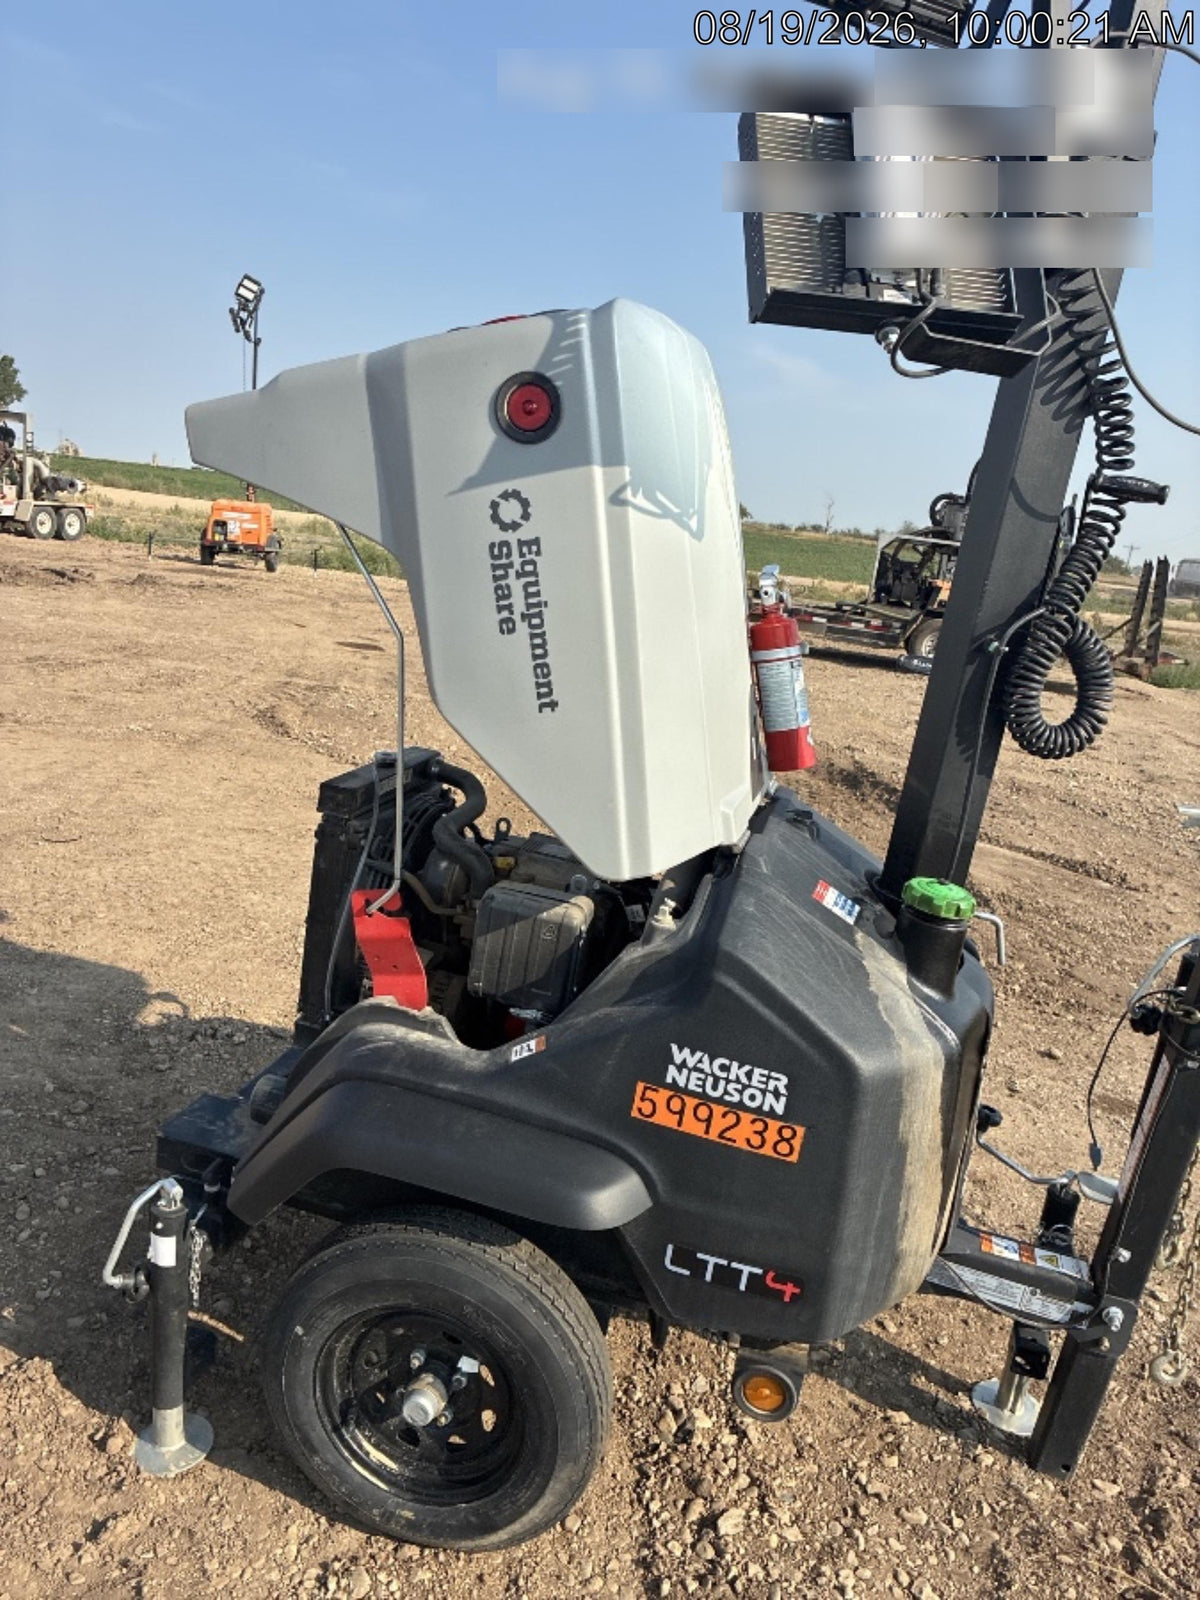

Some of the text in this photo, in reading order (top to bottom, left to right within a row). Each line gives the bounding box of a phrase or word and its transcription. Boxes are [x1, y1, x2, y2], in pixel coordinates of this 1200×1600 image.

[488, 539, 517, 636] Share
[515, 536, 559, 714] Equipment
[665, 1064, 788, 1116] NEUSON
[669, 1043, 789, 1096] WACKER
[637, 1085, 798, 1158] 599238
[664, 1243, 801, 1303] LTT4
